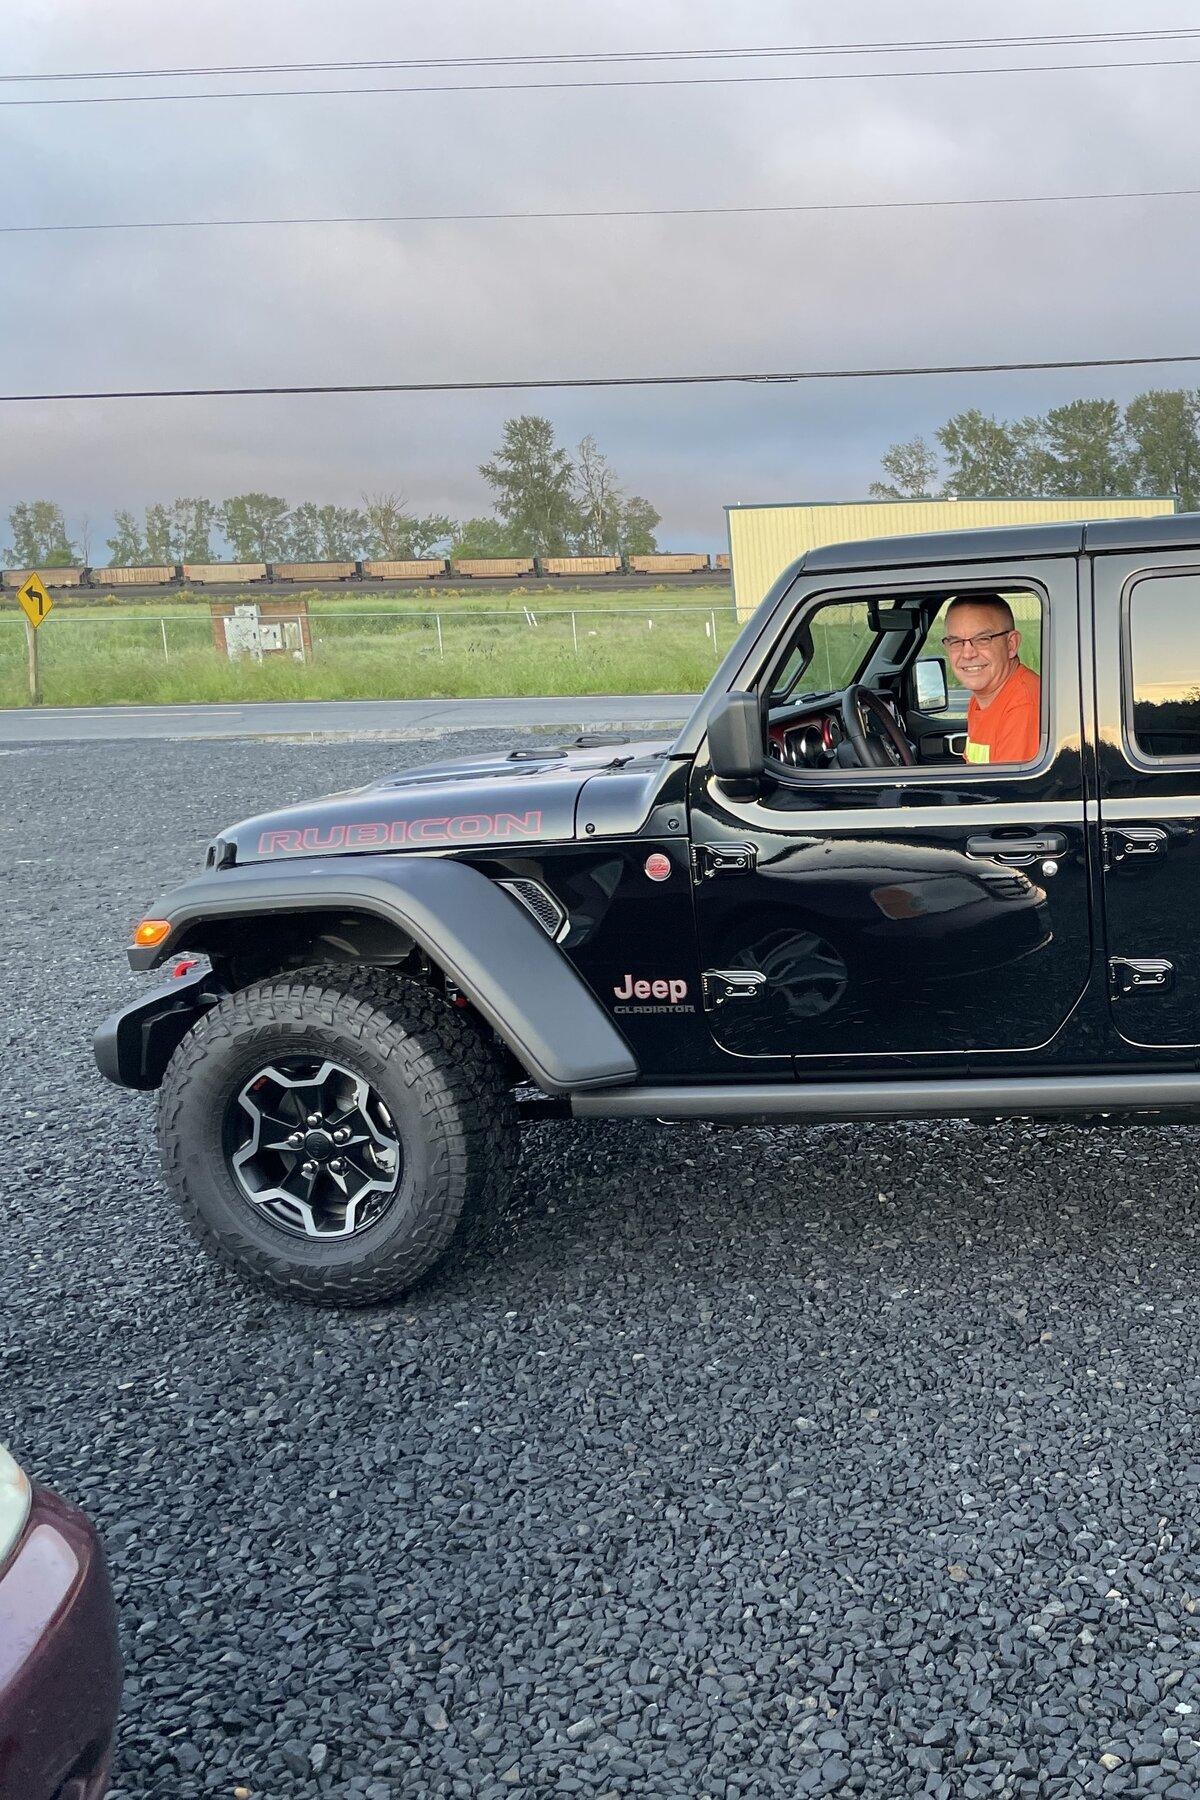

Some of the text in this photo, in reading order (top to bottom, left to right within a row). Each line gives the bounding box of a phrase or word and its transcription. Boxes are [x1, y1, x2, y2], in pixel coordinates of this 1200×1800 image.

[258, 810, 542, 853] RUBICON
[613, 974, 687, 1003] Jeep
[613, 1004, 696, 1014] GLADIATOR
[229, 1022, 388, 1075] FALKEN
